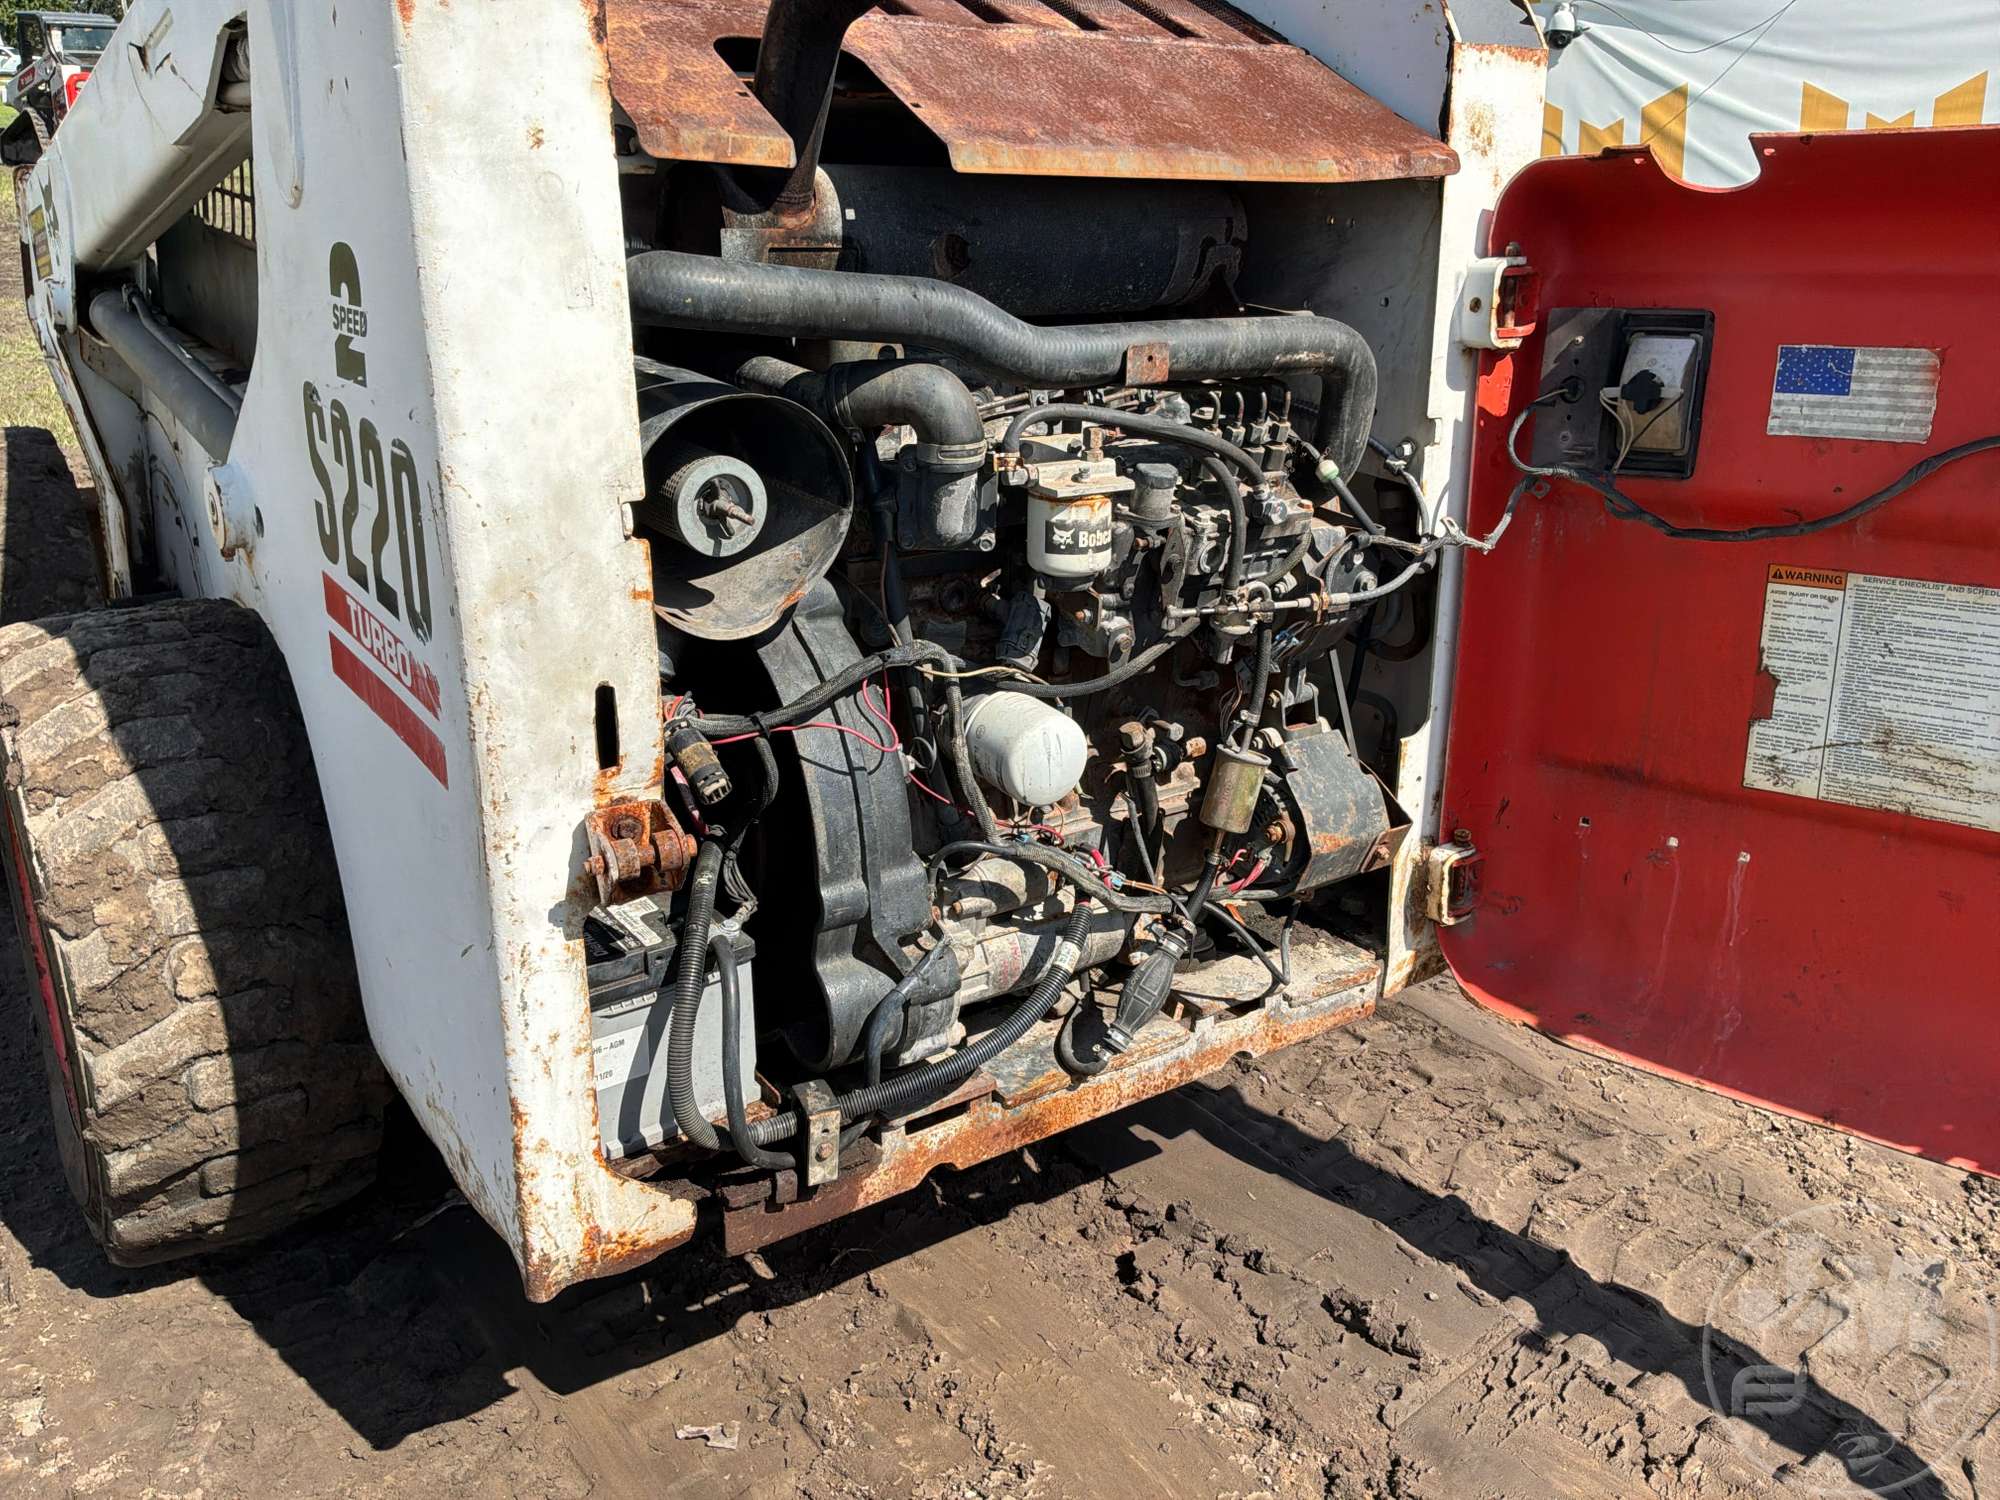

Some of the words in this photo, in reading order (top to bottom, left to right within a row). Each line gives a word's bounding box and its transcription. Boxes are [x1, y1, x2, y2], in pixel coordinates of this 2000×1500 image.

[332, 304, 368, 337] SPEED
[303, 381, 433, 645] S220
[1785, 570, 1843, 585] WARNING
[1862, 576, 1897, 586] SERVICE
[1898, 579, 1946, 591] CHECKLIST
[346, 594, 413, 688] TURBO
[609, 1038, 626, 1049] AGM
